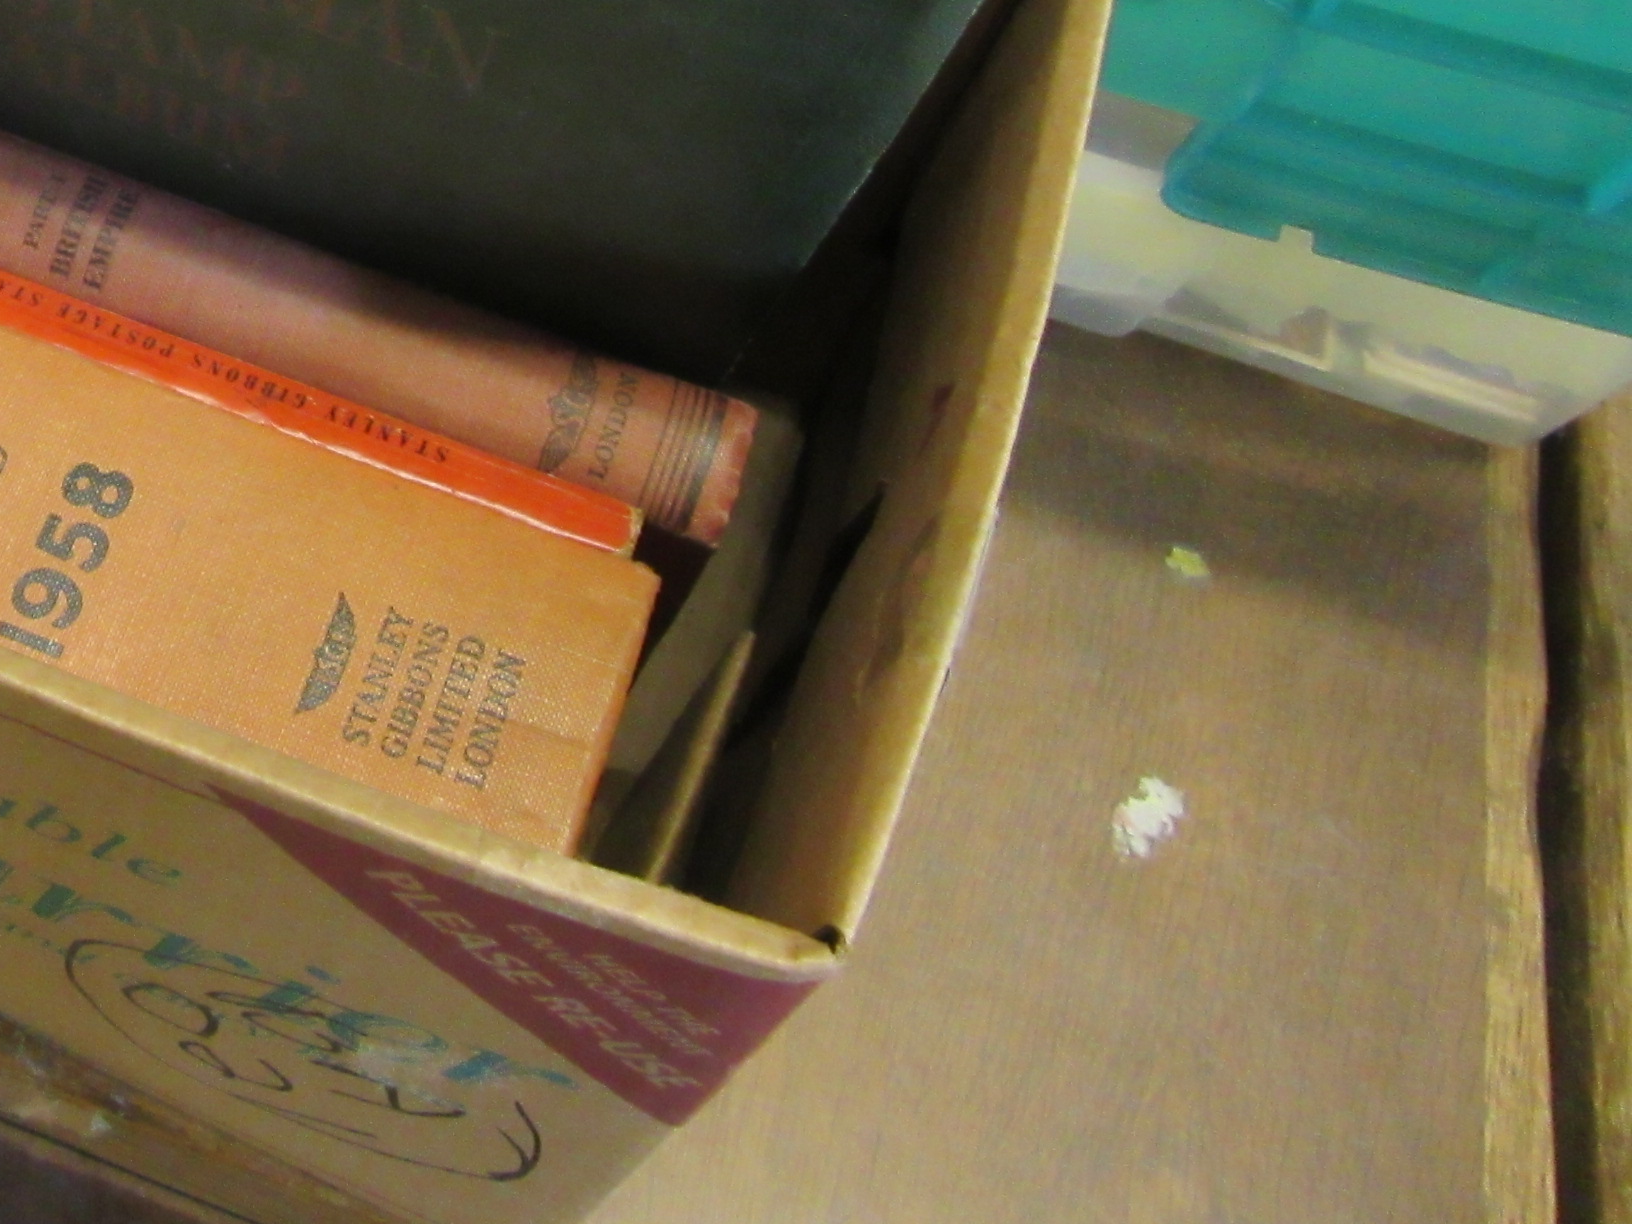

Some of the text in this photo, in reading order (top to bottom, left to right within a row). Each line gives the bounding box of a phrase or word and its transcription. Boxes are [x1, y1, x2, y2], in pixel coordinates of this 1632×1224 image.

[49, 173, 107, 278] BRITISH
[85, 187, 140, 292] EMPIRE
[54, 302, 176, 359] POSTAGE
[190, 353, 308, 409] GIBBONS
[323, 404, 450, 464] STANLEY
[586, 373, 642, 481] LONDON
[343, 606, 414, 747] STANLEY
[381, 621, 449, 758] GIBBONS
[416, 635, 485, 774] LIMITED
[454, 648, 526, 790] LONDON
[365, 868, 554, 988] PLEASE
[534, 993, 701, 1091] RE-USE
[507, 923, 711, 1058] ENVIRONMENT
[588, 951, 665, 1006] HELP
